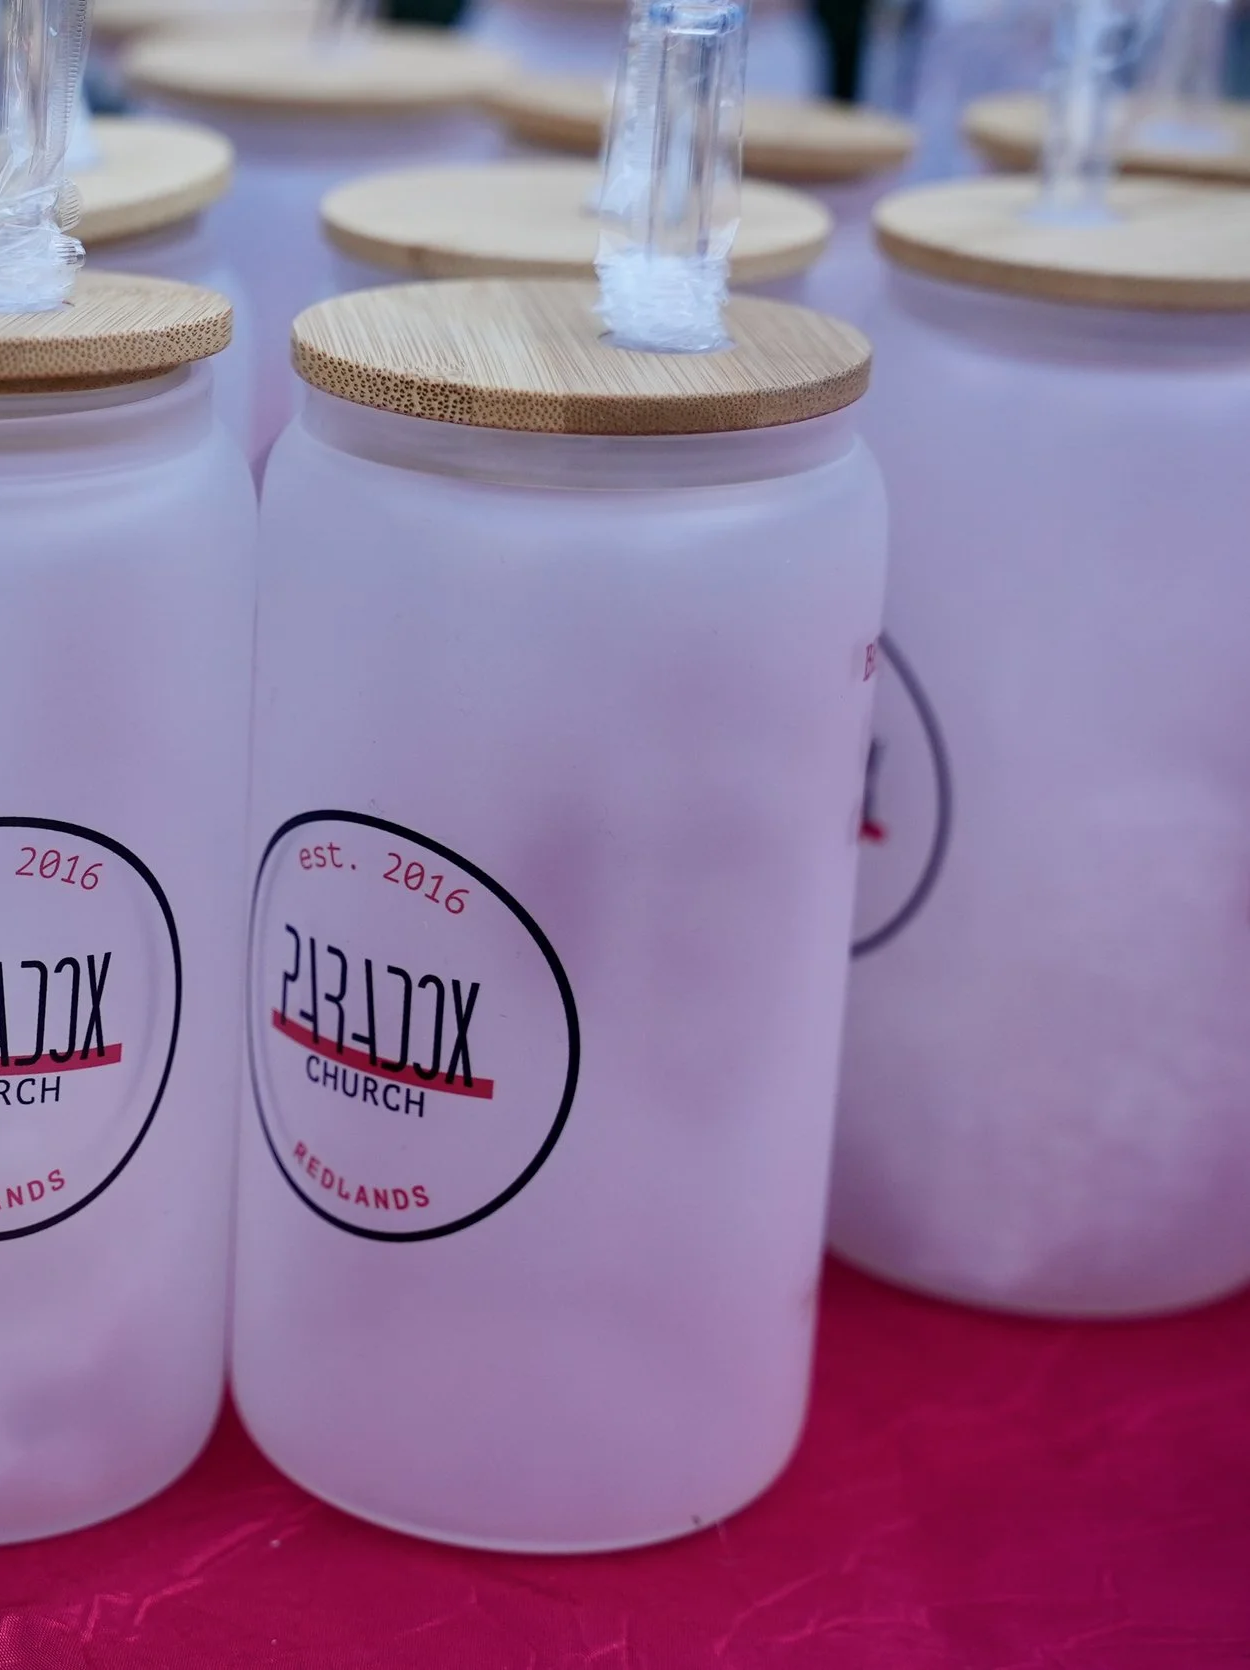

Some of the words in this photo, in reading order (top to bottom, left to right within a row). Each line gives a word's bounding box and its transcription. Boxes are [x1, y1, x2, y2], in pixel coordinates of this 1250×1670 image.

[14, 846, 104, 890] 2016
[299, 840, 357, 870] est.
[382, 851, 471, 915] 2016
[279, 923, 482, 1089] PARADOX
[305, 1055, 426, 1119] CHURCH
[292, 1140, 431, 1211] REDLANDS
